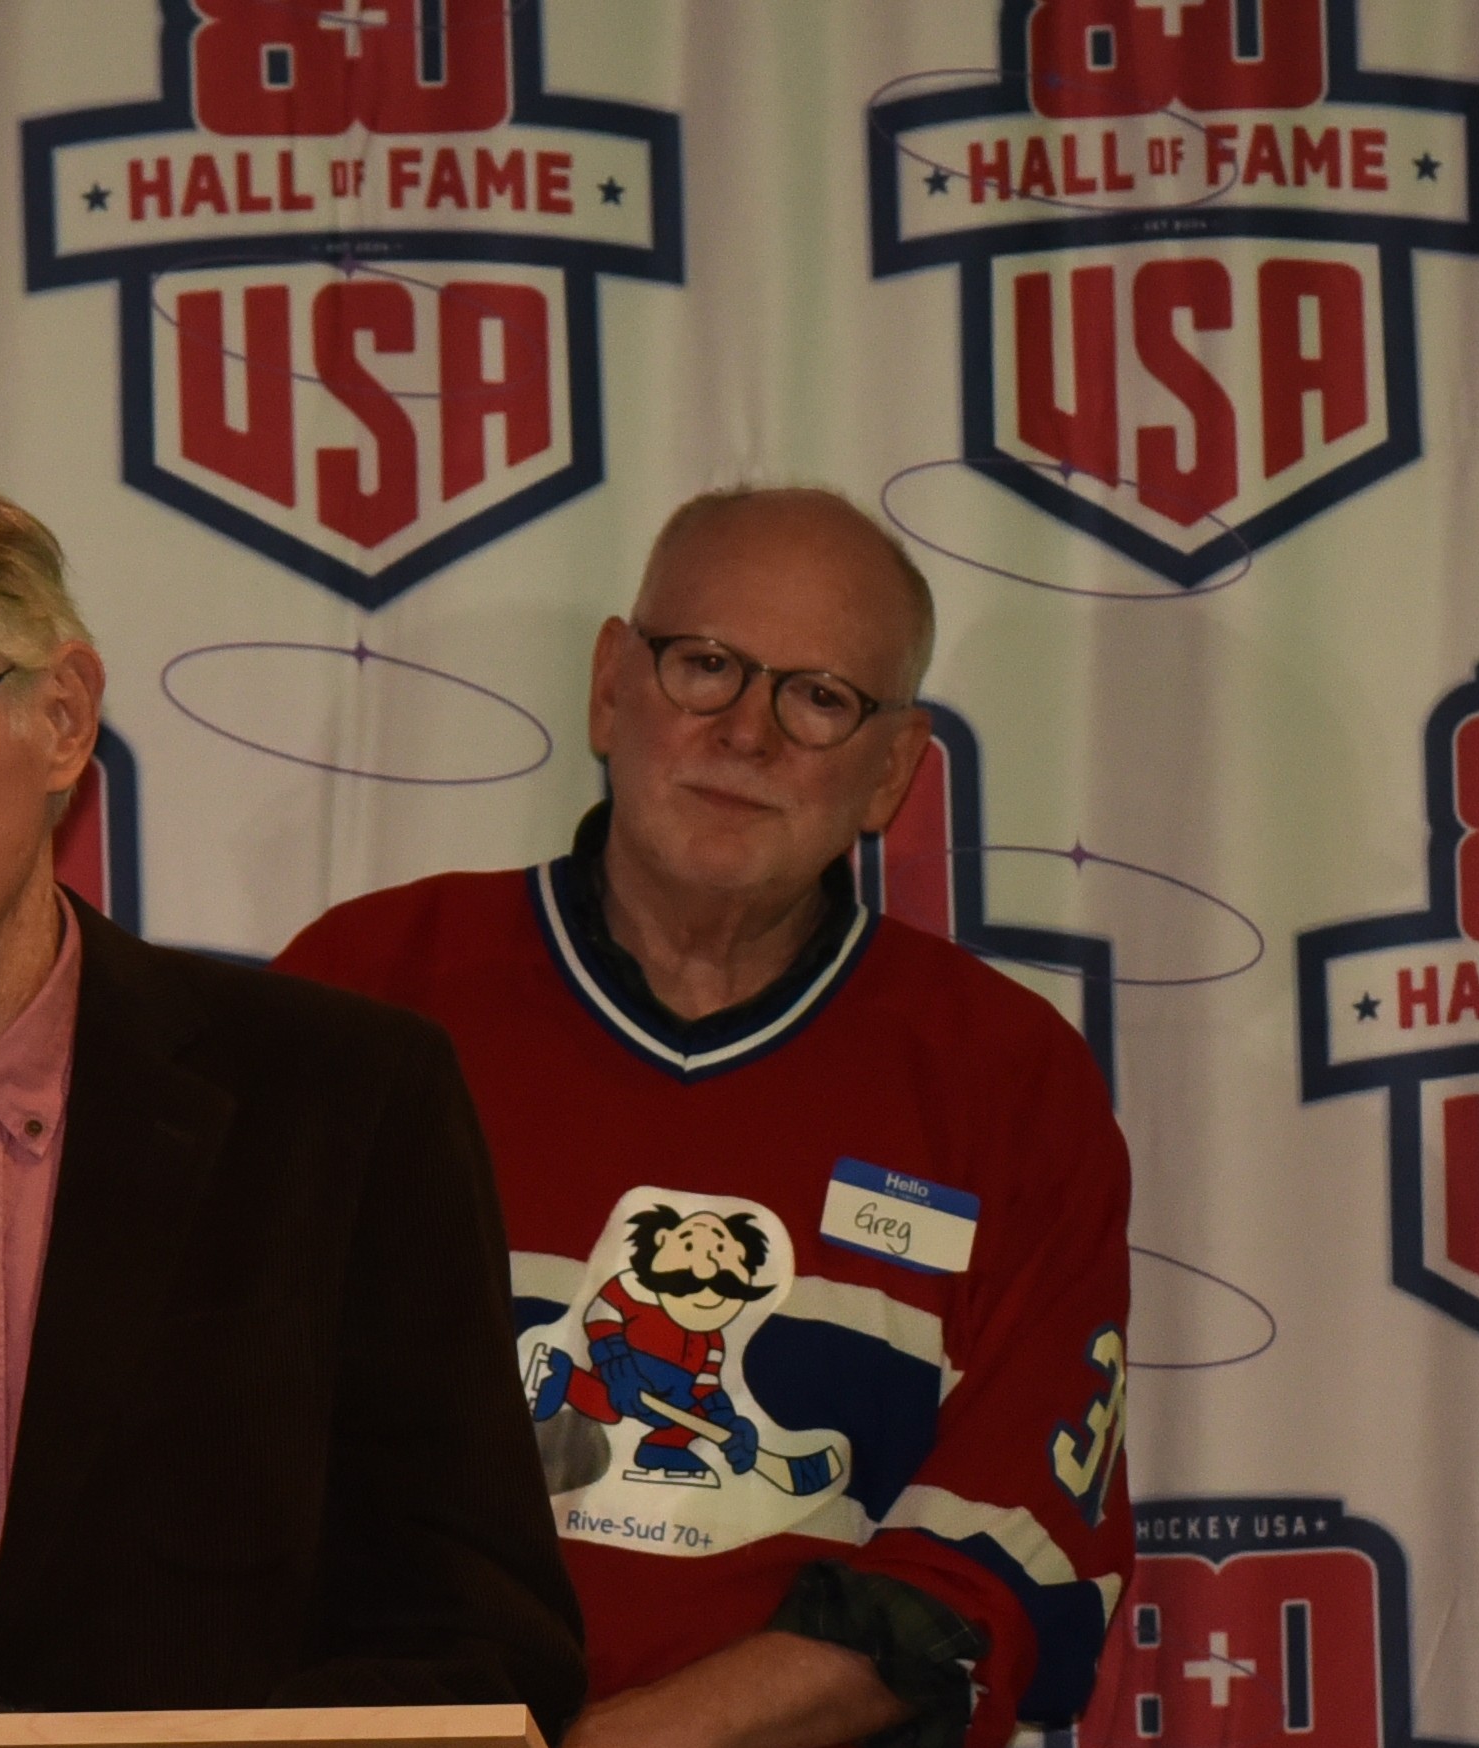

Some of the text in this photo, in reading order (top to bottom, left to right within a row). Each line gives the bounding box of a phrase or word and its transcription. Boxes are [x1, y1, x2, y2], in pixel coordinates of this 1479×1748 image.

[130, 149, 571, 219] HALL OF FAME
[970, 125, 1386, 202] HALL OF FAME
[177, 282, 550, 548] USA
[1015, 259, 1366, 526] USA
[884, 1172, 930, 1198] Hello
[854, 1201, 912, 1256] Greg
[565, 1509, 714, 1550] Rive-Sud 70+
[1136, 1511, 1307, 1539] HOCKEY USA
